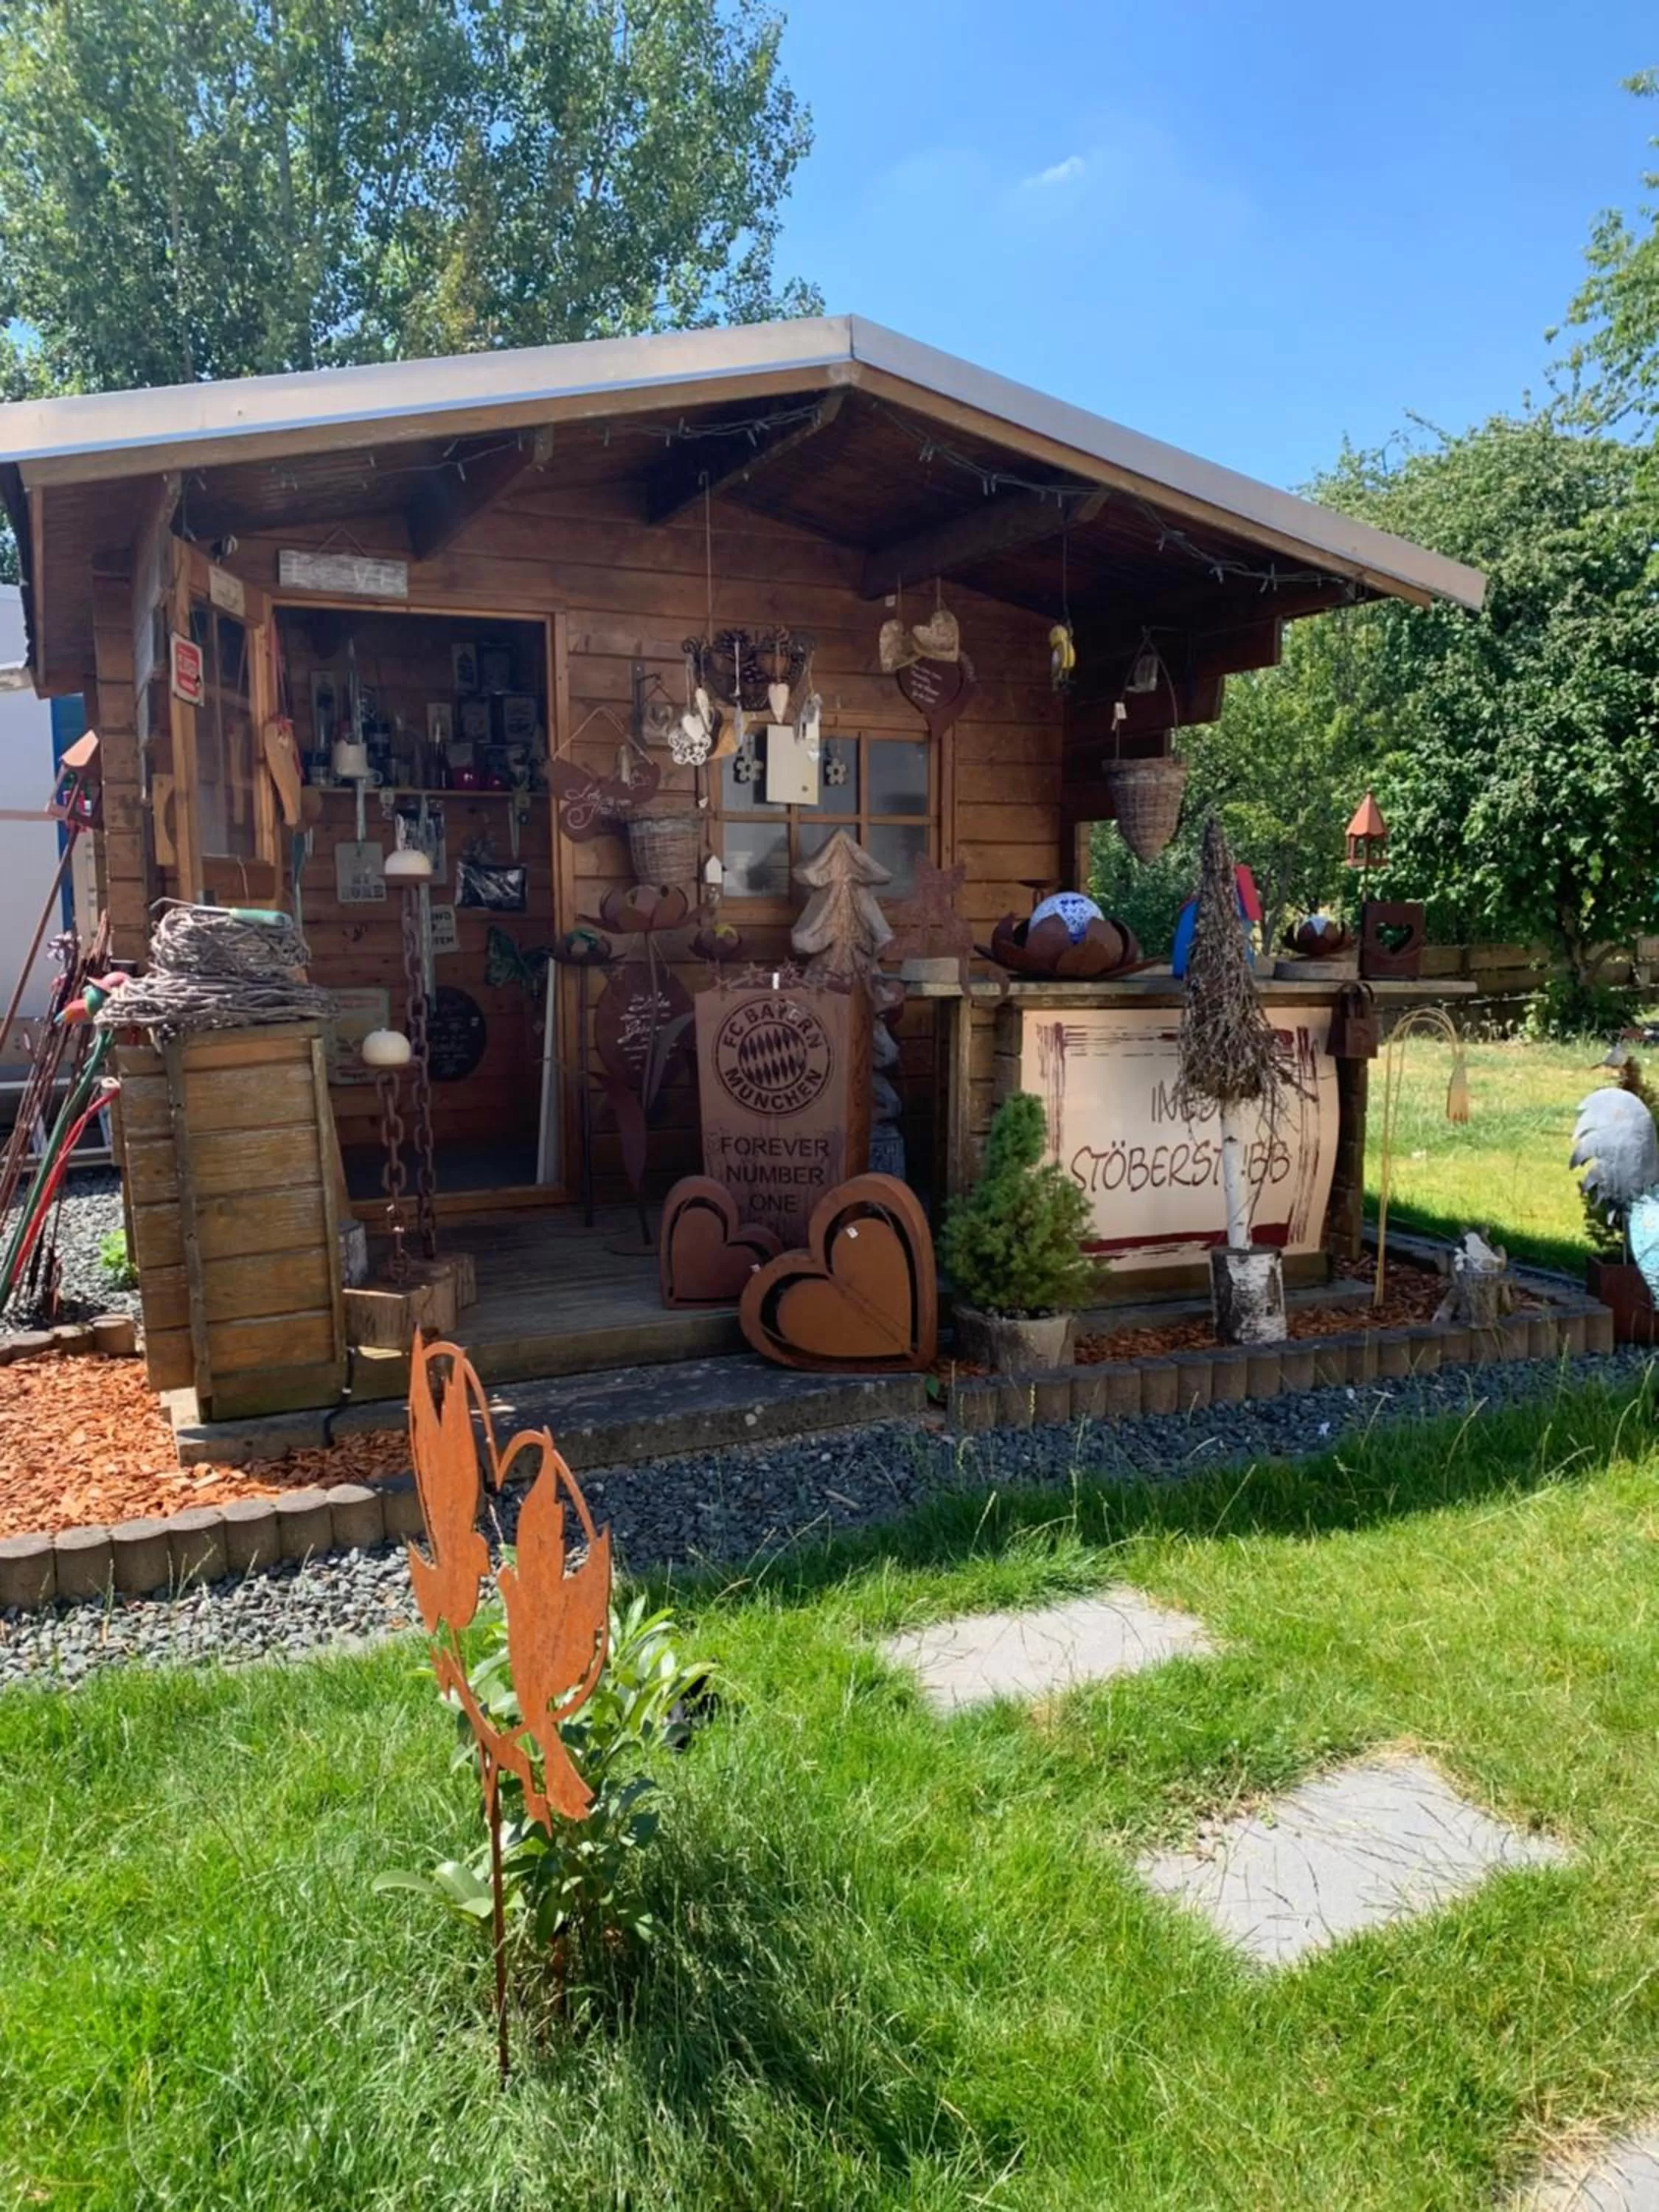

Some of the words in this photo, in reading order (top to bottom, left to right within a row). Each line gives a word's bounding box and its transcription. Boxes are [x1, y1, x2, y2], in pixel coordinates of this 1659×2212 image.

[723, 1021, 744, 1048] FC
[744, 1004, 824, 1048] BAYERN
[720, 1136, 830, 1157] FOREVER
[726, 1166, 824, 1186] NUMBER
[1071, 1139, 1291, 1192] STÖBERSTBB
[749, 1194, 798, 1214] ONE
